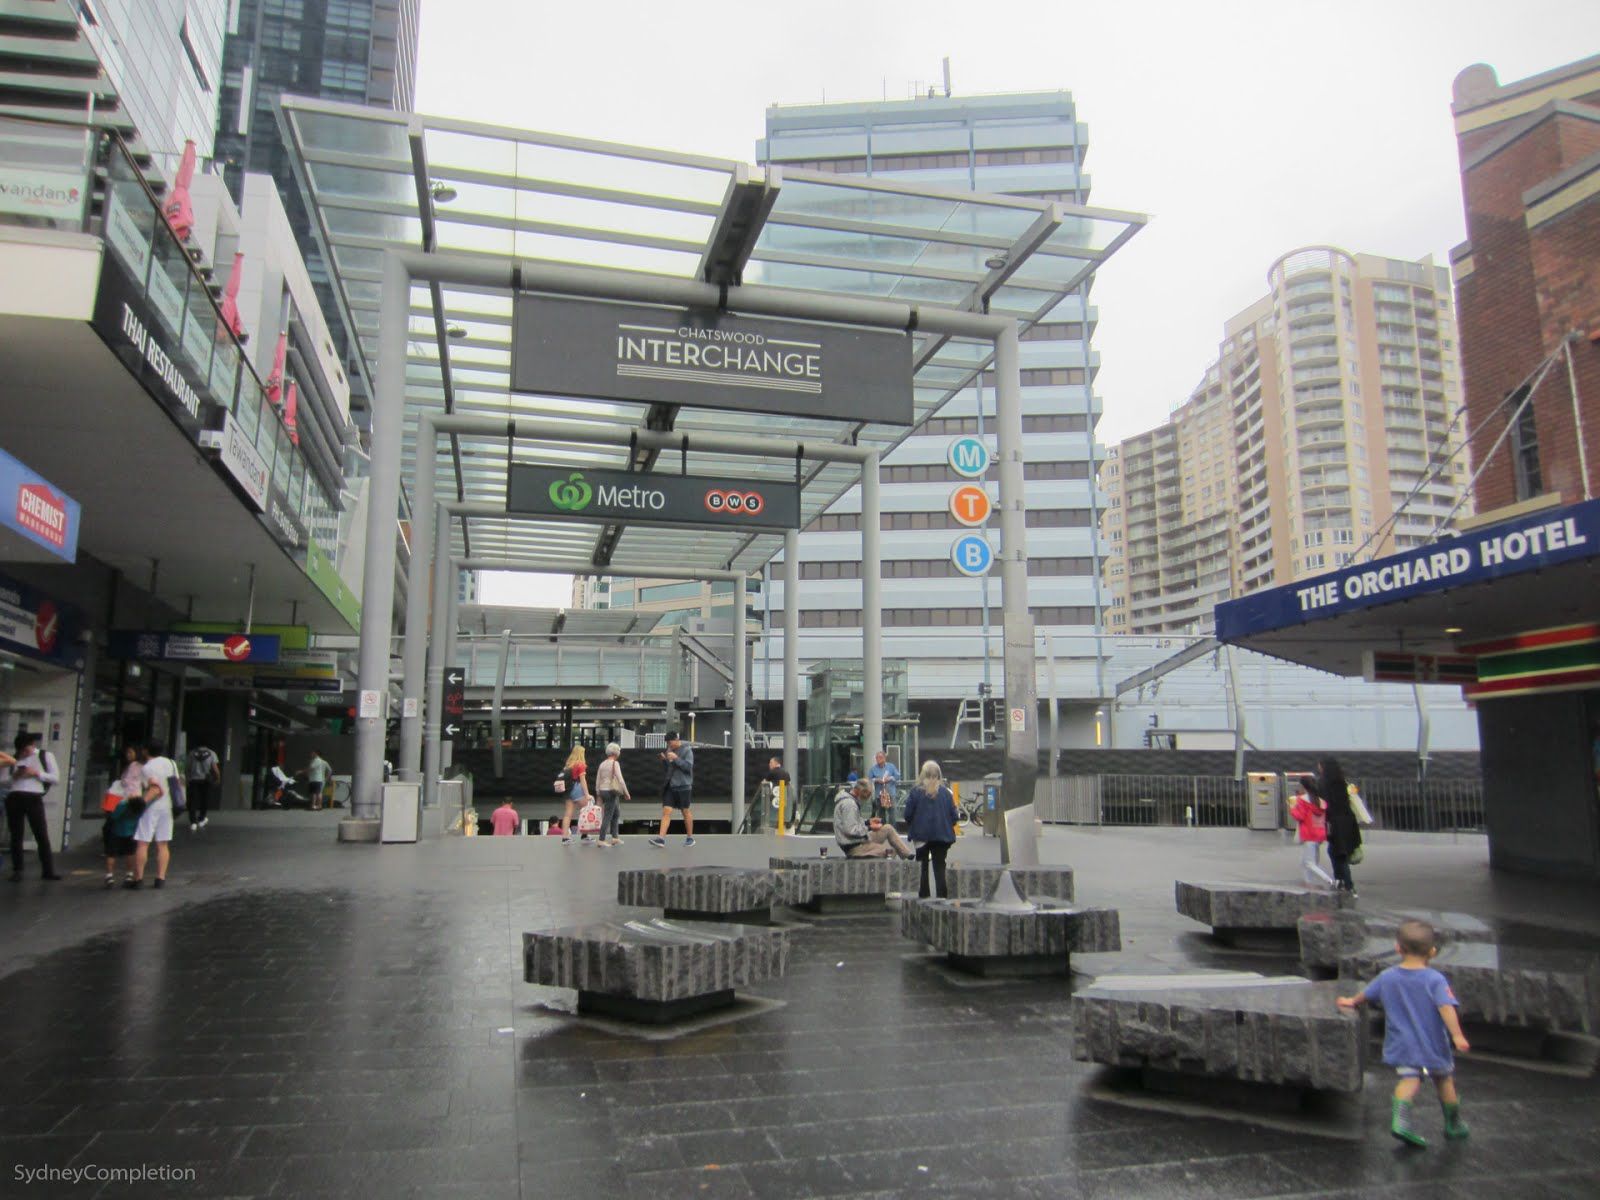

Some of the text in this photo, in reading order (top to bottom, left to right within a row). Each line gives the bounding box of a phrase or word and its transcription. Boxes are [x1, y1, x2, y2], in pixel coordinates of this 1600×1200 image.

[678, 327, 765, 346] CHATSWOOD
[121, 302, 147, 354] THAI
[147, 337, 200, 419] RESTAURANT
[618, 336, 821, 378] INTERCHANGE
[958, 444, 981, 468] M
[20, 487, 65, 532] CHEMIST
[597, 484, 760, 511] Metro BWS
[962, 494, 980, 518] T
[965, 543, 983, 567] B
[1297, 517, 1587, 612] THE ORCHARD HOTEL
[320, 695, 344, 704] Metro
